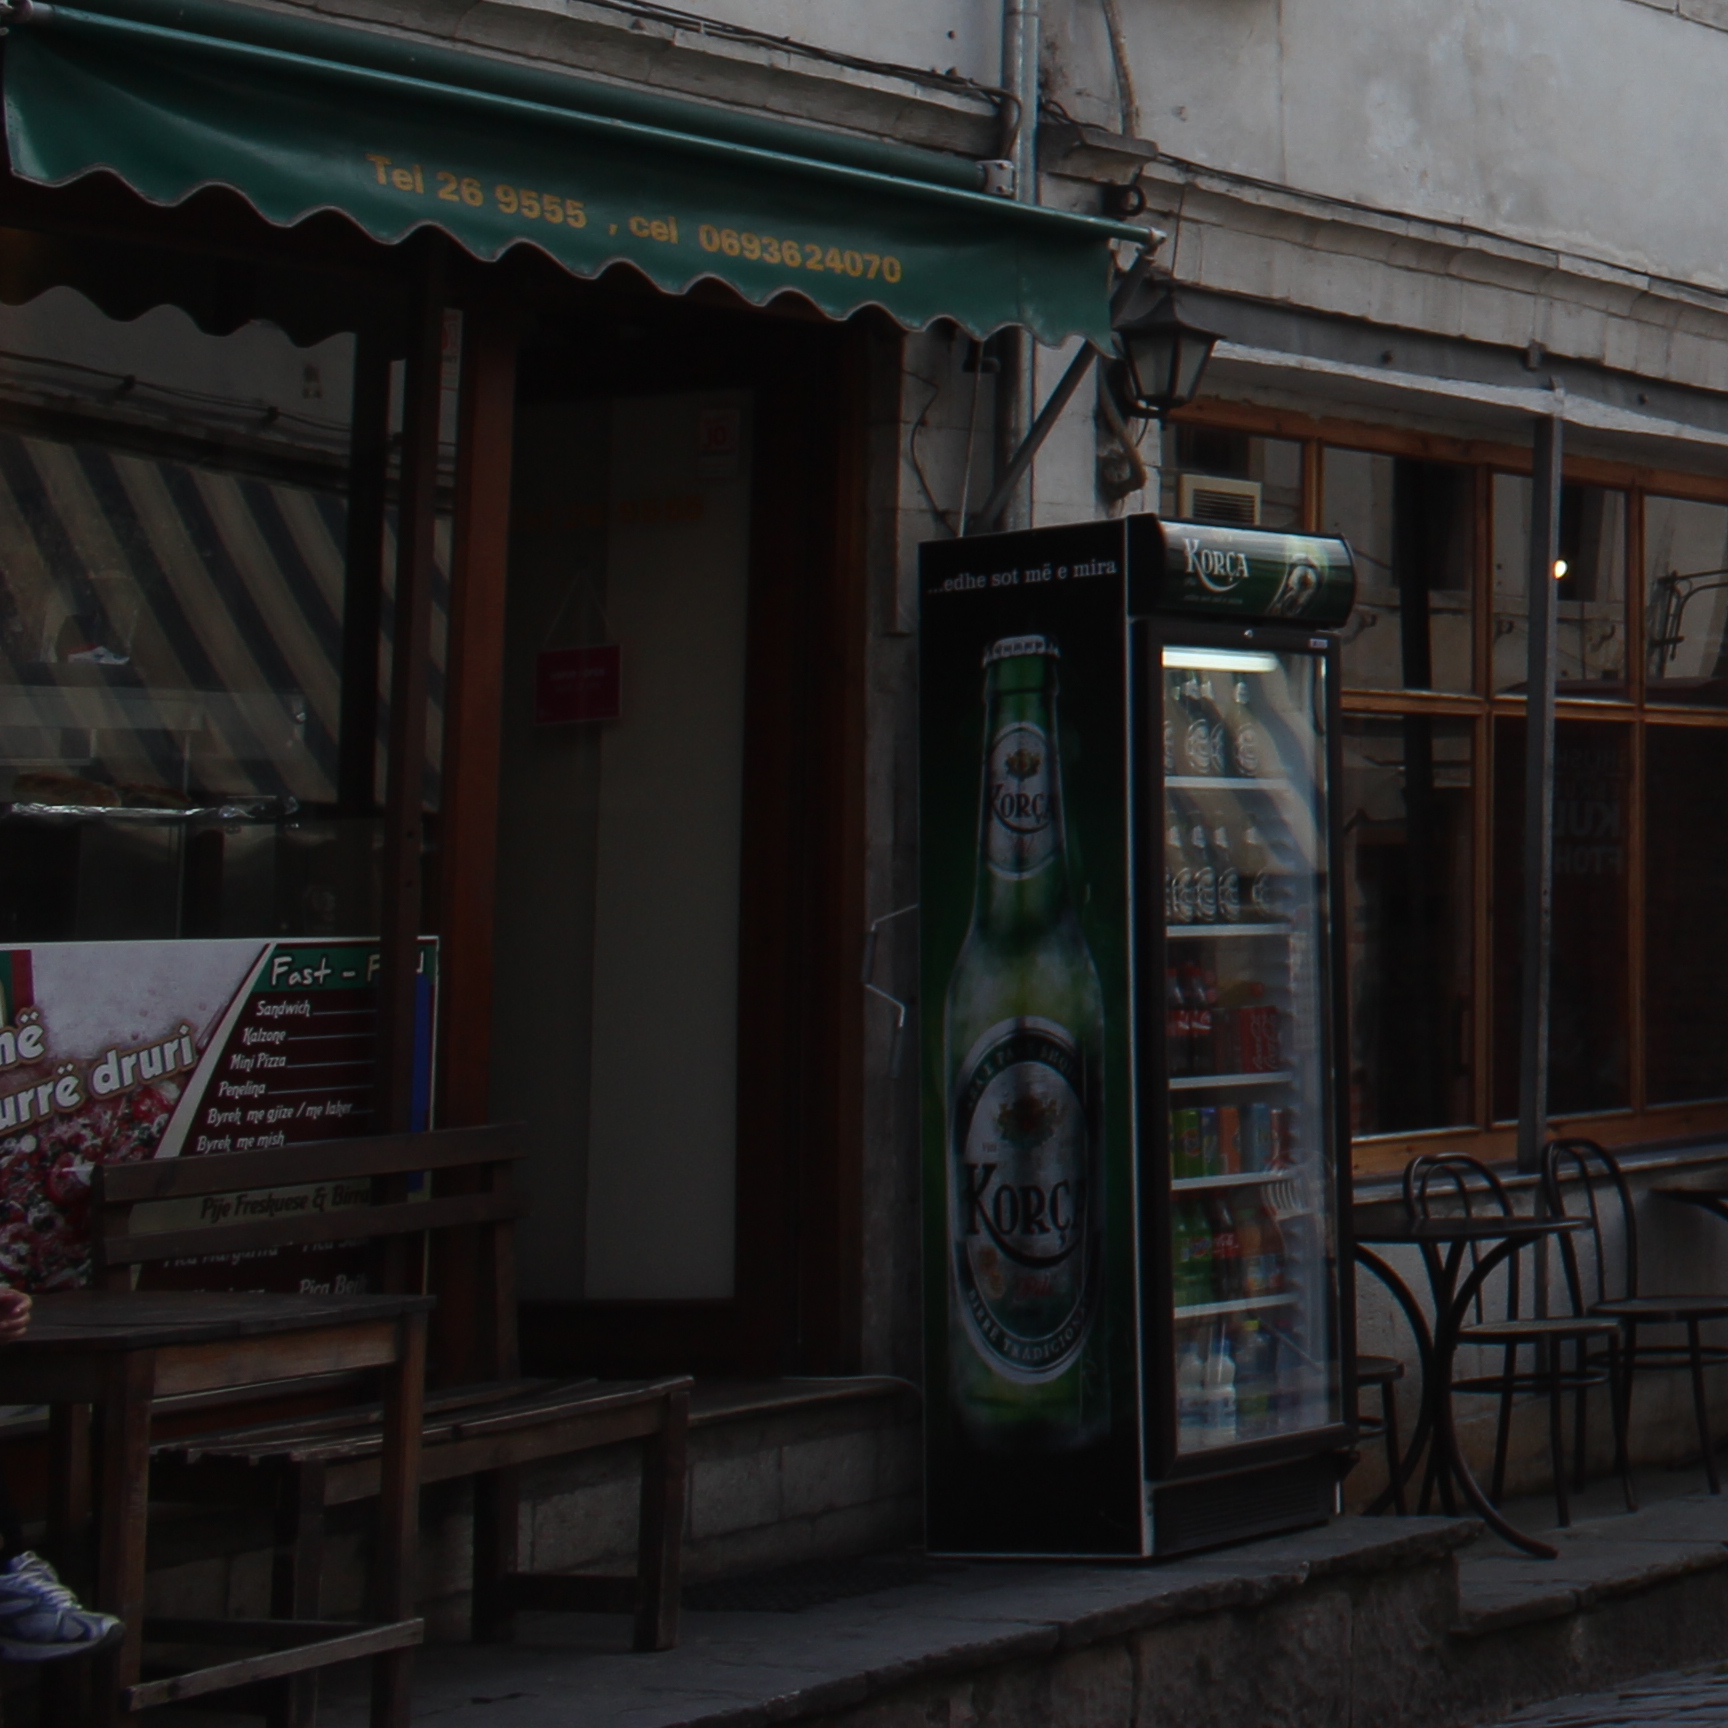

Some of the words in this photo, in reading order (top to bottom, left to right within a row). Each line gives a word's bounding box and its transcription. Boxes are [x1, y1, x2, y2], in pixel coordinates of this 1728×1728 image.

[365, 152, 424, 195] Tel
[436, 170, 484, 207] 26
[495, 184, 588, 229] 9555
[628, 211, 678, 245] cel
[699, 223, 902, 284] 0693624070
[991, 567, 1019, 587] sot
[1025, 562, 1052, 584] më
[1057, 567, 1067, 579] e
[1073, 558, 1116, 577] mira
[271, 956, 332, 986] Fast
[256, 999, 310, 1019] Sandwich
[243, 1027, 286, 1045] Kalzone
[93, 1024, 194, 1095] druri
[229, 1054, 254, 1072] Mini
[256, 1052, 286, 1068] Pizza
[207, 1107, 242, 1127] Byrek
[247, 1110, 265, 1125] me
[306, 1106, 323, 1121] me
[197, 1135, 232, 1154] Byrek
[237, 1136, 255, 1151] me
[257, 1130, 285, 1148] mish
[200, 1196, 231, 1222] Pije
[234, 1192, 307, 1217] Freskuese
